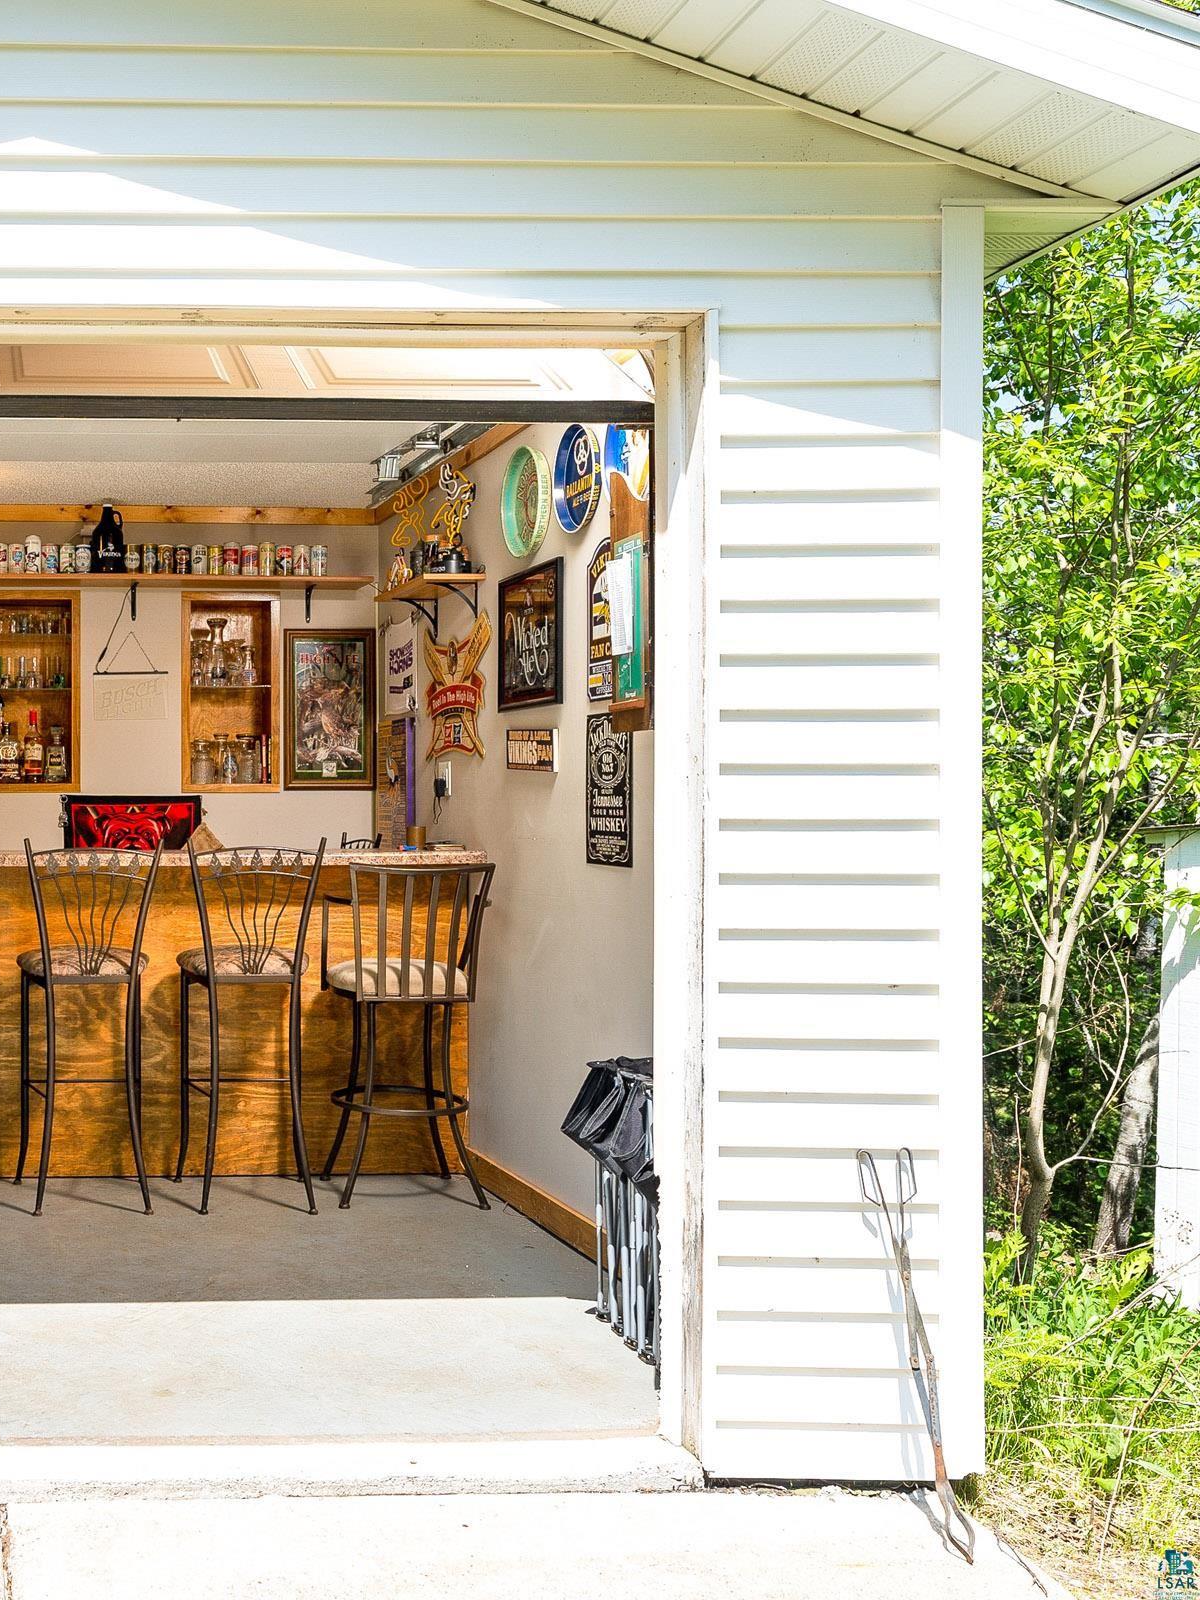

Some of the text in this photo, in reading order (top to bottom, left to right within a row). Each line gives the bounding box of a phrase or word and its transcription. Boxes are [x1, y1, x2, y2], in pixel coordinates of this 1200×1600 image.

[566, 473, 593, 499] BALLANTIN
[504, 612, 549, 660] Wicked
[332, 653, 360, 664] LFE
[591, 642, 604, 659] FAN
[508, 741, 553, 765] VIKINGS FAN
[602, 753, 613, 763] Old
[592, 808, 607, 816] SOUR
[590, 817, 626, 832] WHISKEY
